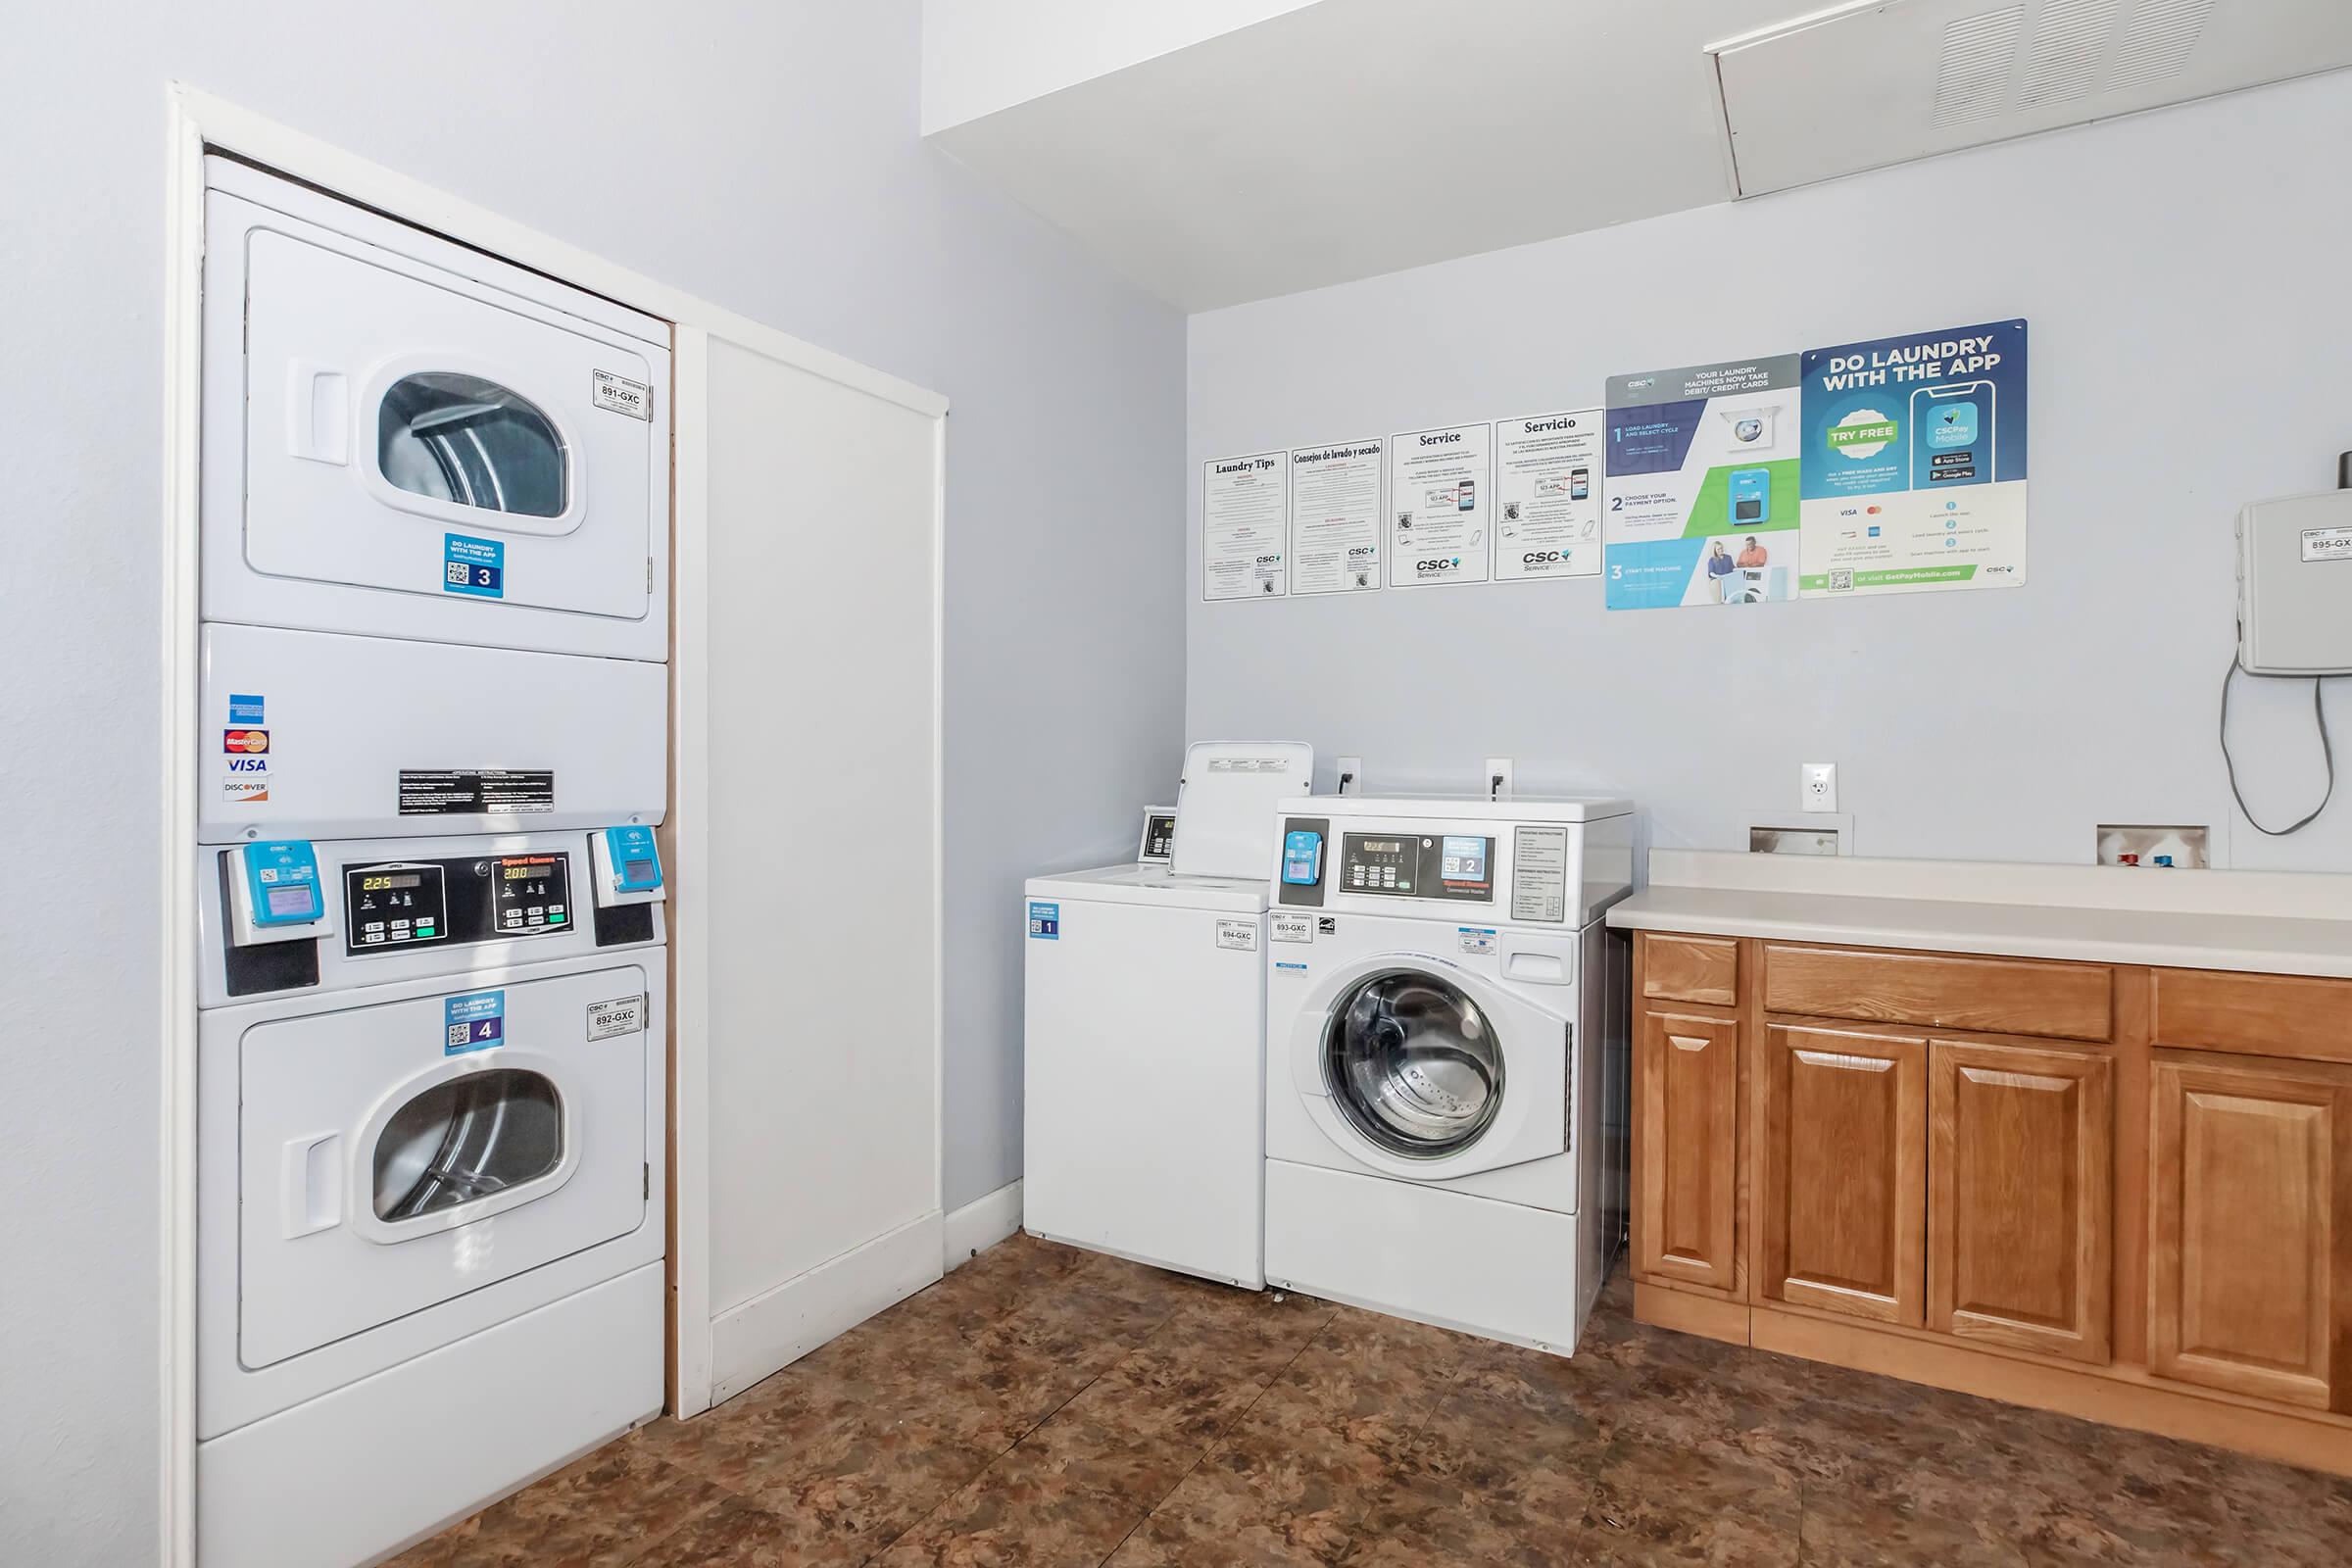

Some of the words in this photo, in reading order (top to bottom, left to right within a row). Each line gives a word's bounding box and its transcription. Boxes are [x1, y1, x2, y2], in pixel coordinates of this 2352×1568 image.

[1830, 354, 1865, 374] DO
[1872, 335, 1993, 368] LAUNDRY
[1685, 378, 1725, 388] MACHINES
[1726, 375, 1746, 384] NOW
[1748, 371, 1769, 380] TAKE
[1695, 370, 1718, 379] YOUR
[1719, 367, 1757, 377] LAUNDRY
[1823, 369, 1886, 392] WITH
[1892, 361, 1941, 382] THE
[1948, 353, 2001, 376] APP
[1628, 378, 1646, 388] CSC
[1684, 386, 1710, 396] DEBIT/
[1711, 383, 1740, 393] CREDIT
[1741, 380, 1769, 390] CARDS
[602, 386, 640, 405] 891-GXC
[1524, 417, 1576, 433] Servicio
[1419, 432, 1461, 447] Service
[1614, 427, 1622, 443] 1
[1831, 429, 1856, 442] TRY
[1859, 426, 1893, 439] FREE
[1294, 452, 1322, 465] Consejos
[1331, 449, 1352, 459] lavado
[1353, 450, 1358, 459] y
[1358, 446, 1380, 455] secado
[1216, 460, 1253, 475] Laundry
[1255, 459, 1275, 471] Tips
[1611, 497, 1623, 512] 2
[464, 542, 494, 552] LAUNDRY
[1348, 547, 1369, 556] CSC
[2313, 539, 2352, 549] 895-GX
[1416, 559, 1449, 570] CSC
[1523, 551, 1559, 564] CSC
[478, 568, 491, 585] 3
[1611, 564, 1623, 580] 3
[1886, 570, 1961, 580] GetPayMobile.com
[227, 760, 267, 771] VISA
[502, 858, 528, 866] Speed
[1465, 859, 1475, 872] 2
[1047, 922, 1052, 933] 1
[1222, 930, 1251, 940] 894-GXC
[1276, 923, 1306, 932] 893-GXC
[596, 1010, 634, 1025] 892-GXC
[478, 1021, 492, 1038] 4
